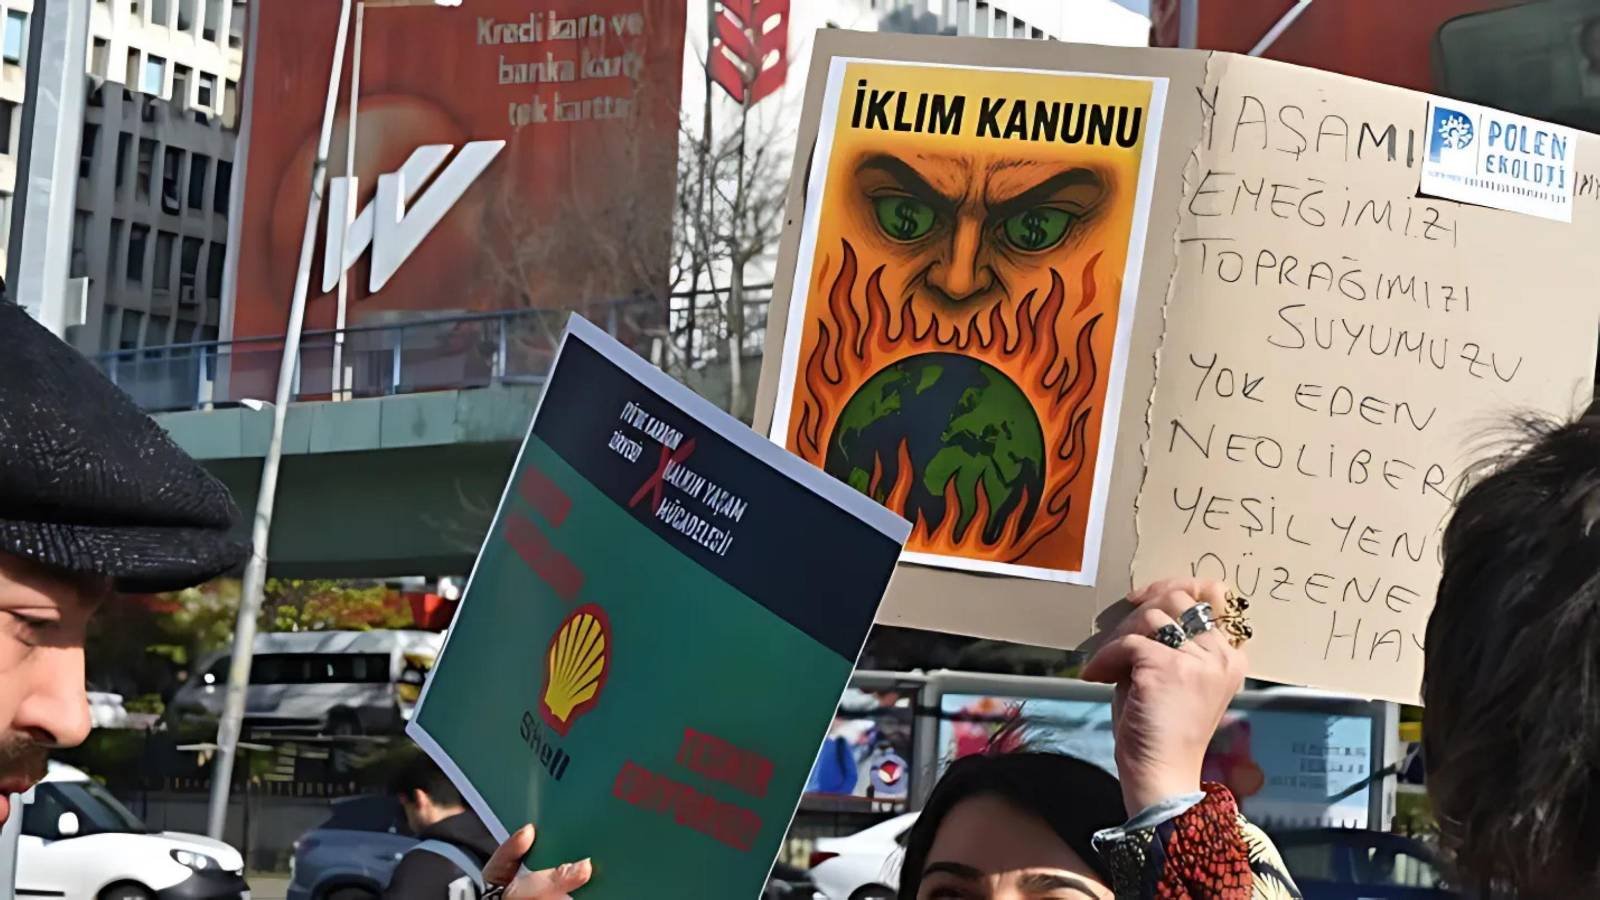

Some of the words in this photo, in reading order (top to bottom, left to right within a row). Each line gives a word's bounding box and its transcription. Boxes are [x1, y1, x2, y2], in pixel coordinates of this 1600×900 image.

[499, 52, 576, 85] banka
[850, 78, 967, 136] İKLIM
[975, 96, 1143, 149] KANUNU
[1487, 119, 1568, 162] POLEN
[1189, 351, 1265, 403] YOK
[1293, 382, 1437, 432] EDEN
[1168, 418, 1455, 504] NEOLİBER
[1172, 485, 1312, 546] YEŞİL
